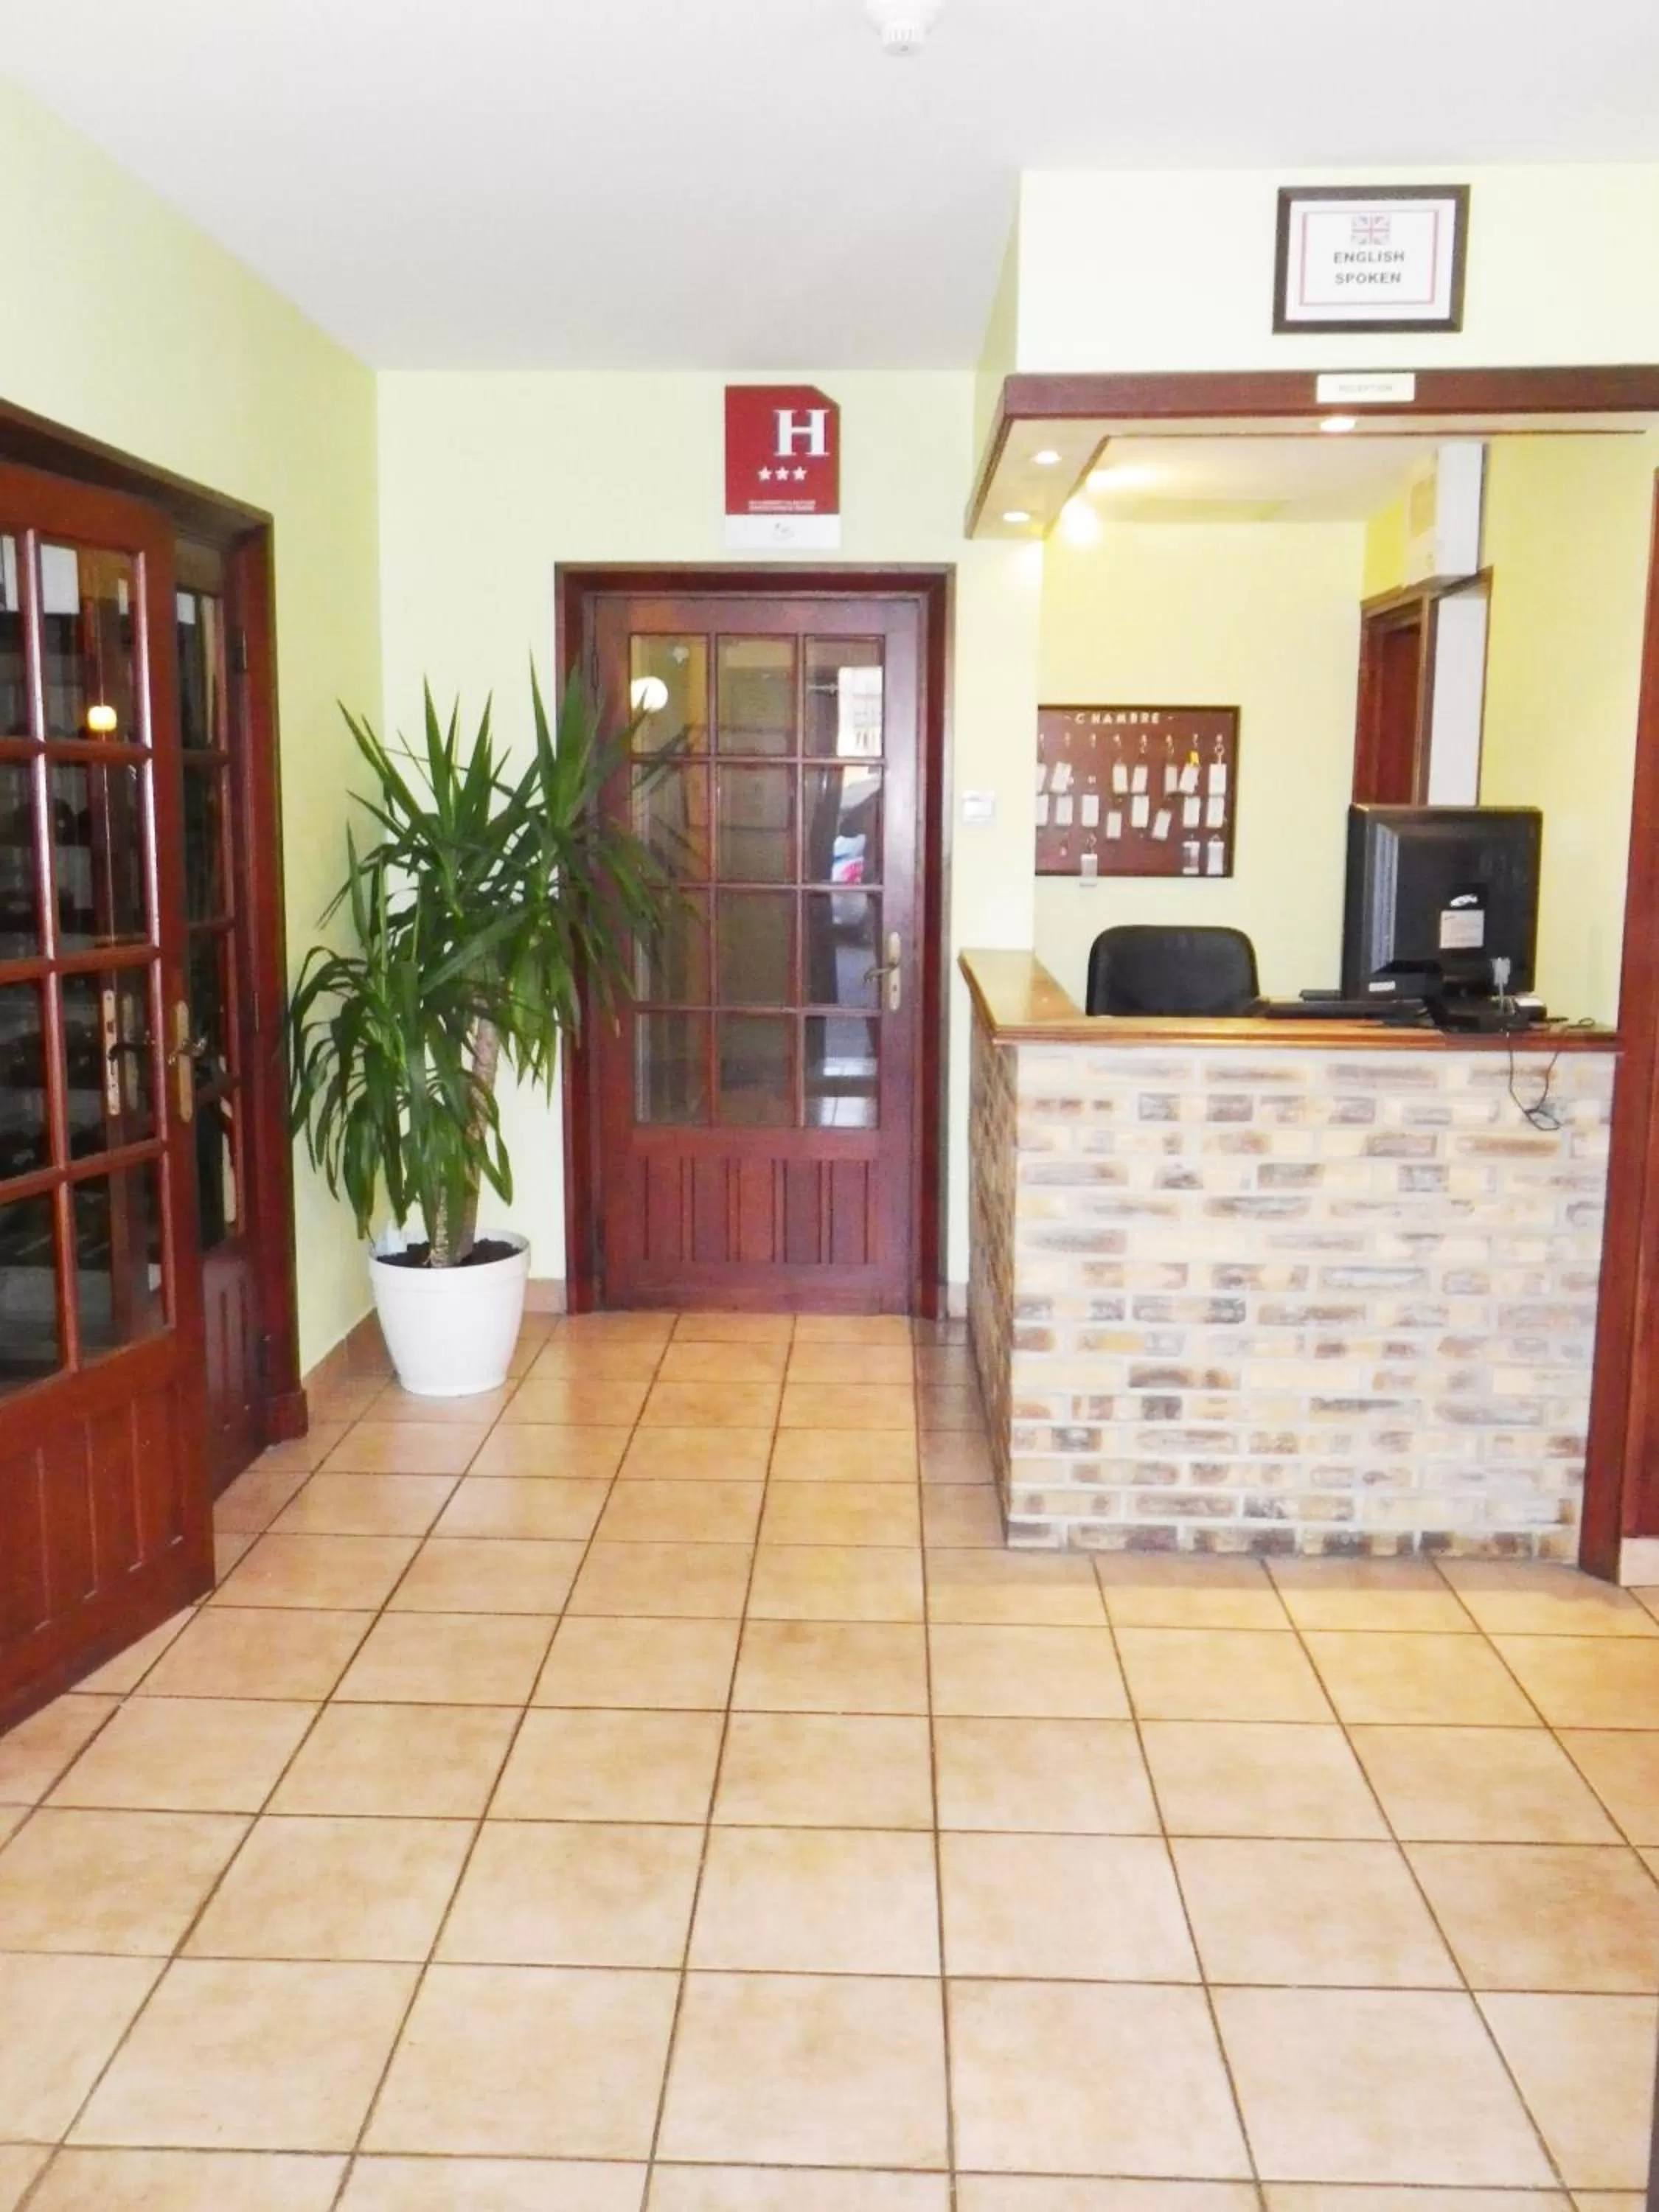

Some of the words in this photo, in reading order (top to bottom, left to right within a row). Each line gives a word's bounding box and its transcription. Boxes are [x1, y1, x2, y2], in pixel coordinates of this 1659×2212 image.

[1333, 251, 1405, 264] ENGLISH
[1335, 271, 1402, 285] SPOKEN
[773, 409, 830, 456] H
